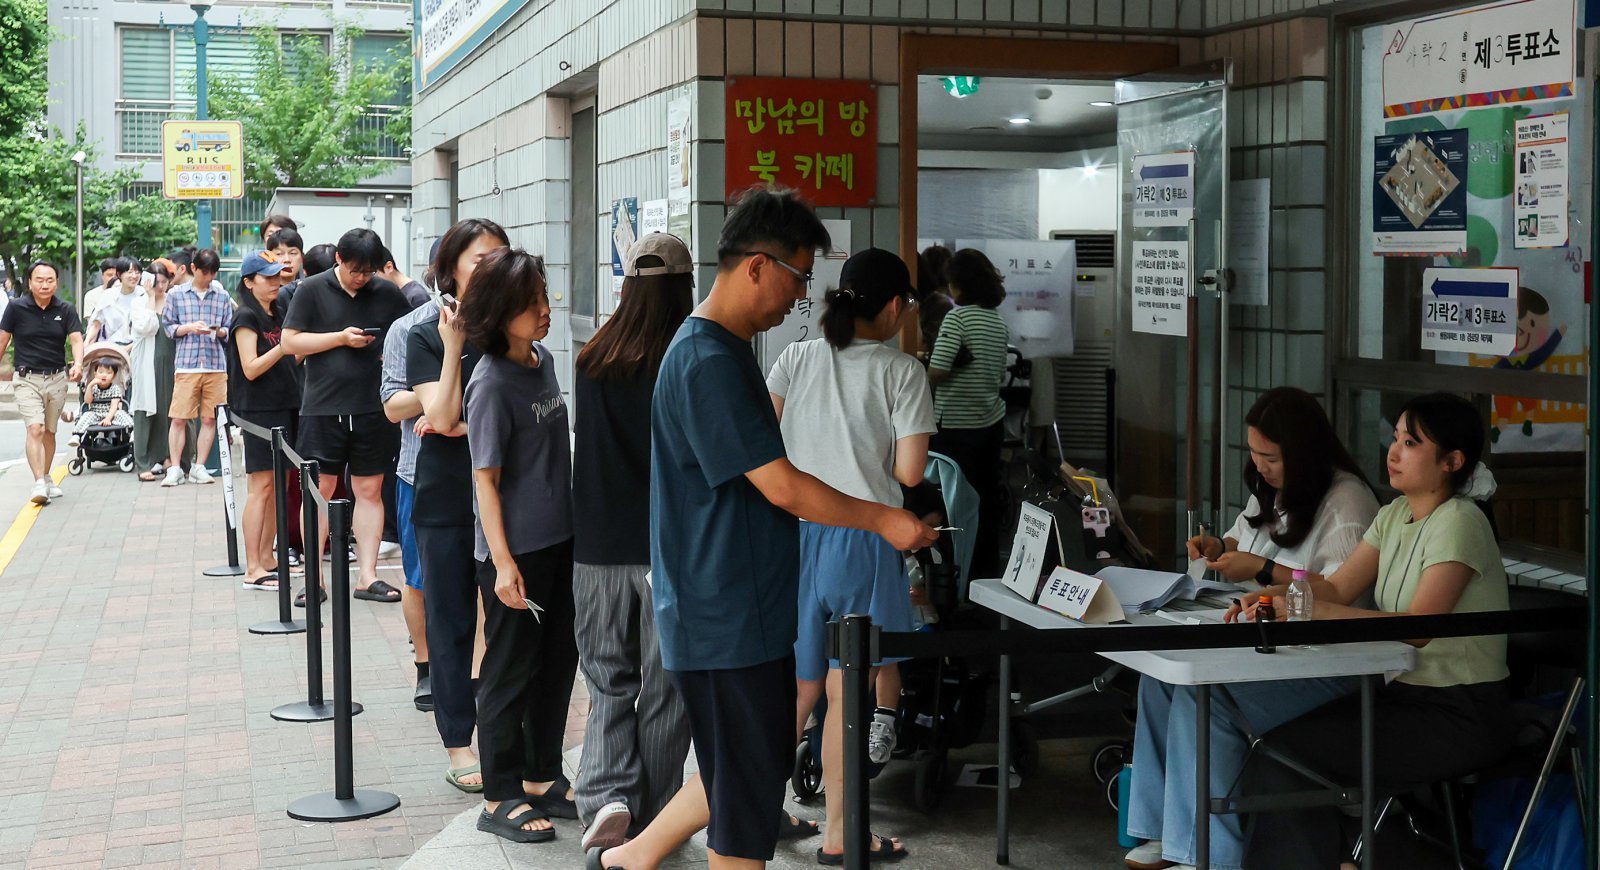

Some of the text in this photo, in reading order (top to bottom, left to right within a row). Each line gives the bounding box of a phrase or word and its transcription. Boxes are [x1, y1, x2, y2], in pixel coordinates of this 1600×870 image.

[735, 96, 869, 137] 만남의 방
[749, 149, 853, 191] 북 카페
[1136, 185, 1156, 203] 가락2
[1166, 261, 1171, 270] 수
[1165, 287, 1170, 297] 수
[1427, 301, 1458, 323] 가락2
[1049, 578, 1091, 606] 투표안내
